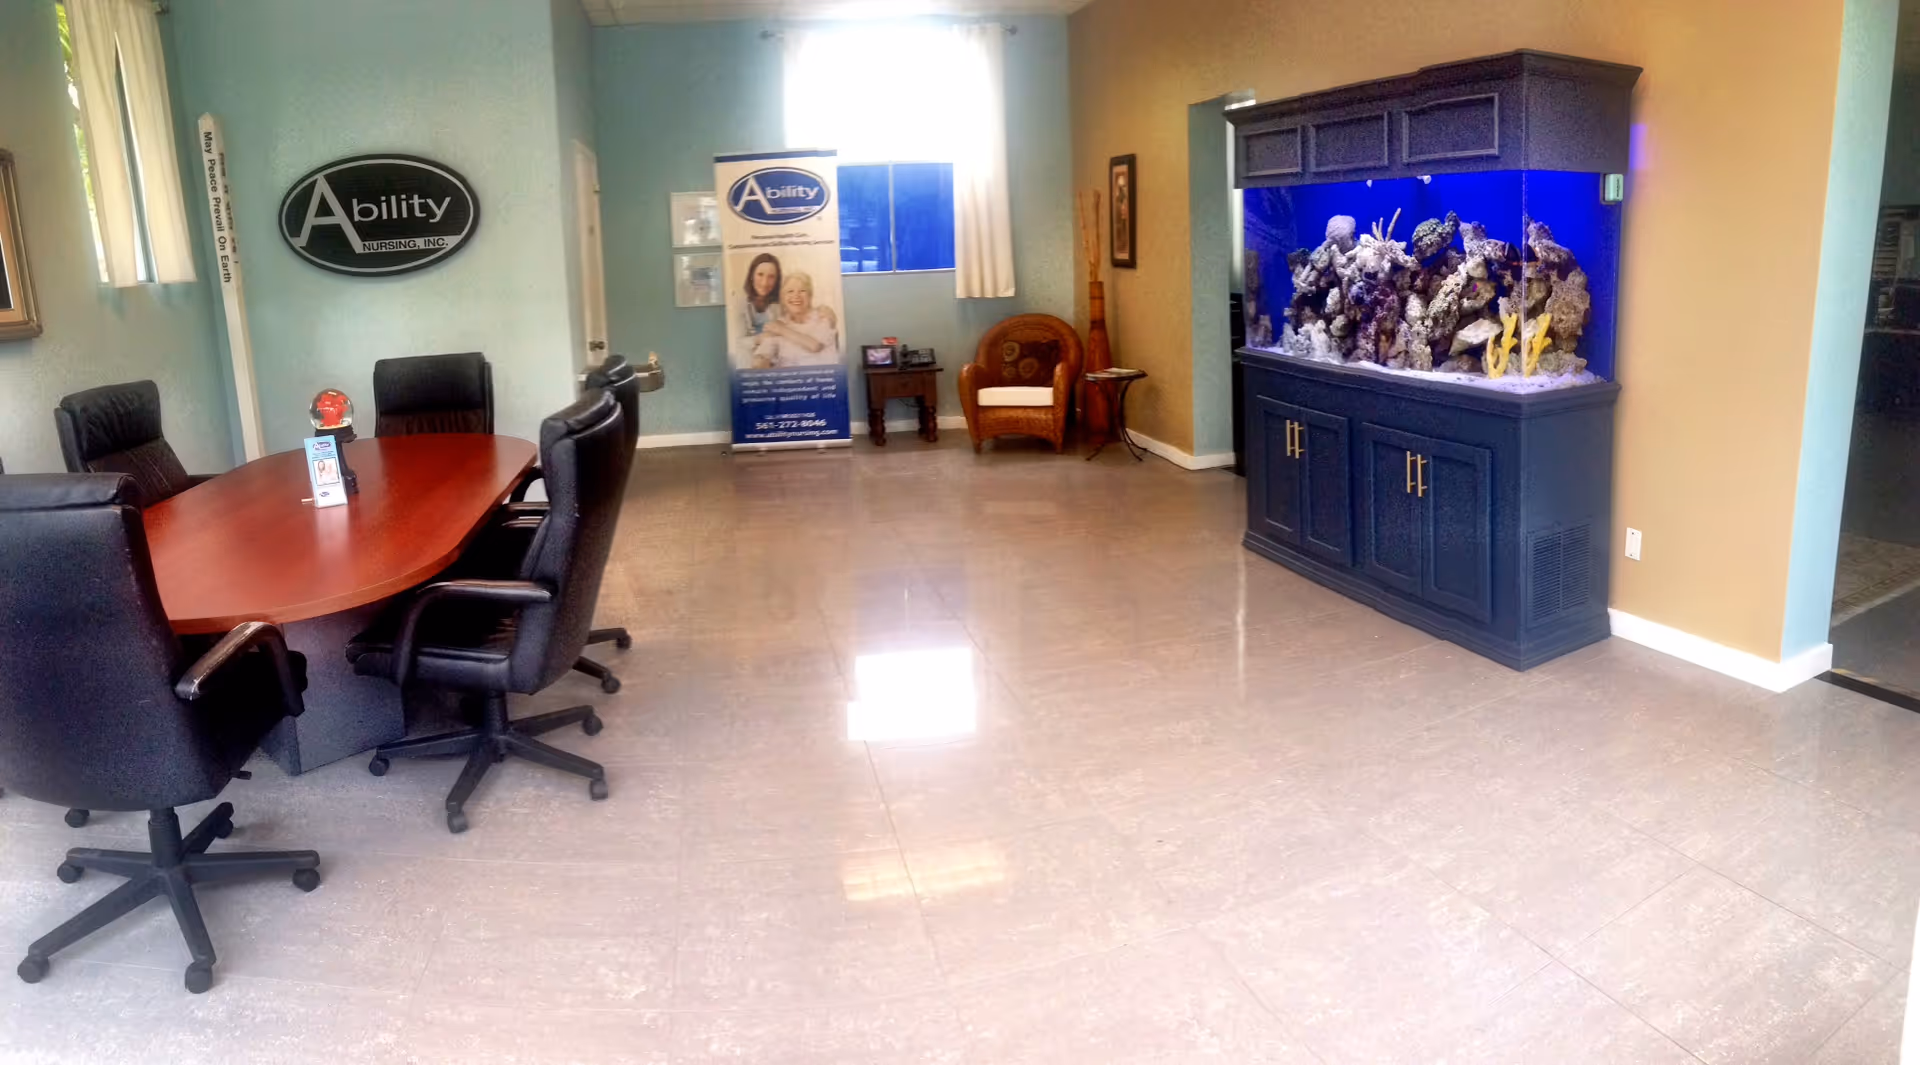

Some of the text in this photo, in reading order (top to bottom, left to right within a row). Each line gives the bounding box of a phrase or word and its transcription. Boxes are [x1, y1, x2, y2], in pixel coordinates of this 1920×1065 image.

[203, 131, 233, 283] May Peace Prevail On Earth
[299, 174, 452, 254] Ability
[736, 175, 820, 215] Ability
[361, 236, 449, 252] NURSING, INC.
[755, 418, 827, 430] 561-272-8046
